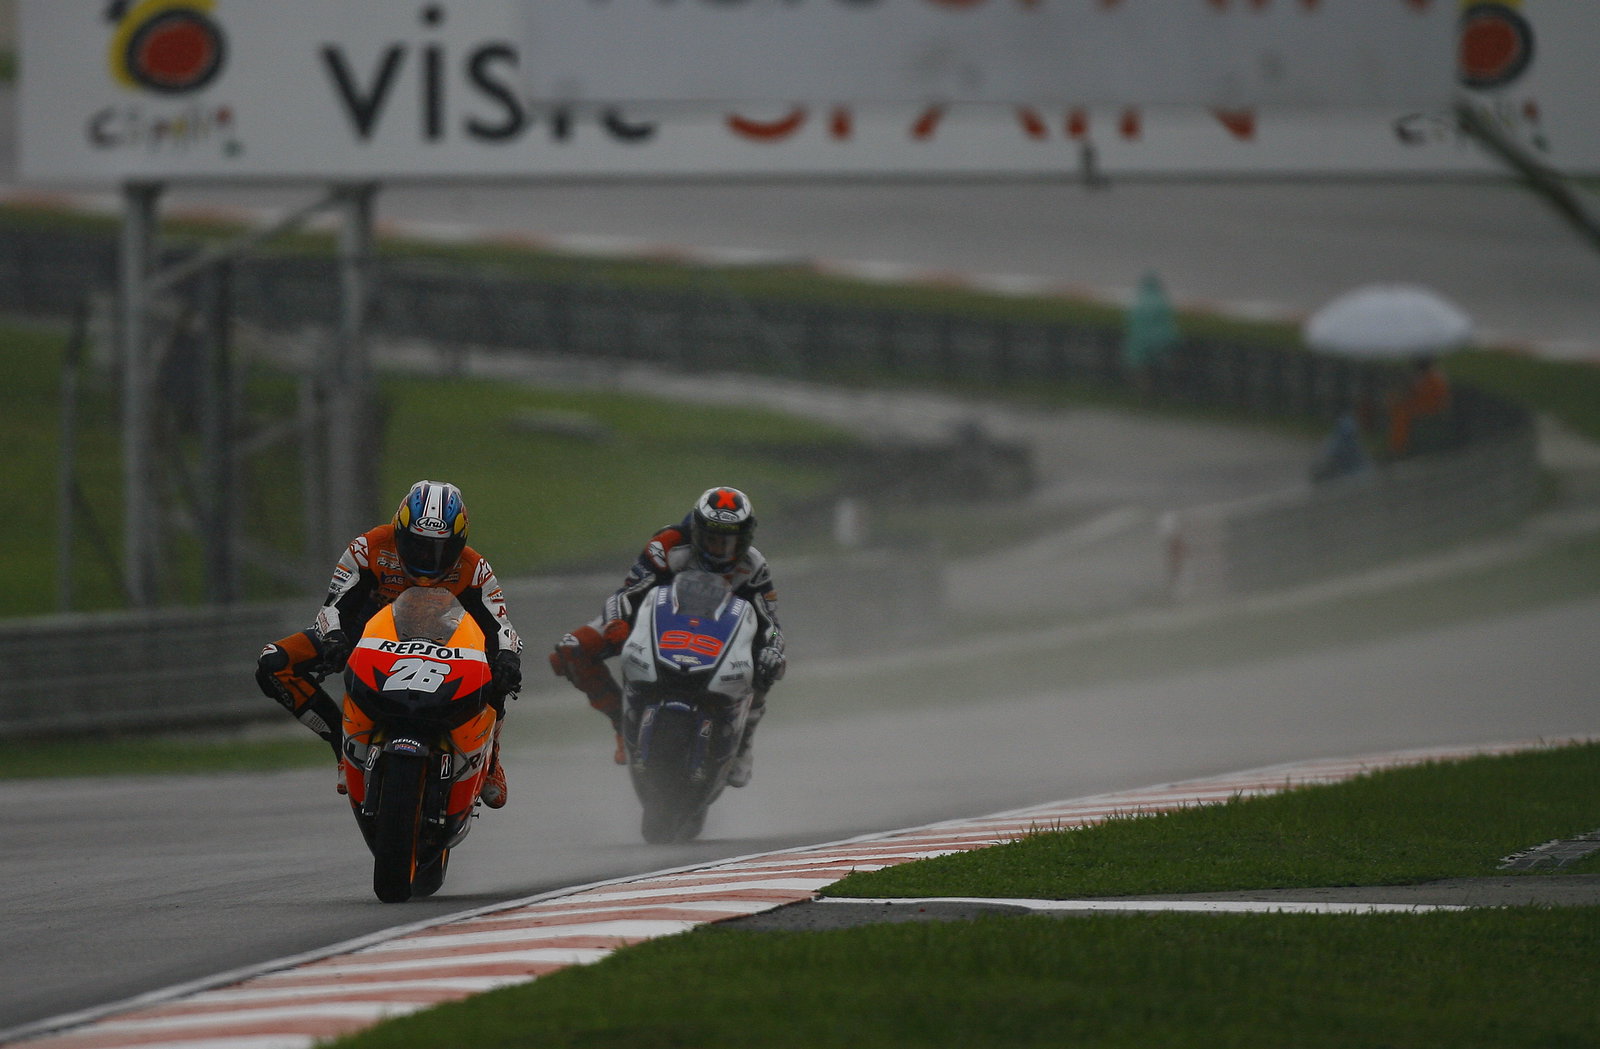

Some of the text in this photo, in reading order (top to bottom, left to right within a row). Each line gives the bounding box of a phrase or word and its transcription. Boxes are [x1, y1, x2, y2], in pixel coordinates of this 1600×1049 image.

[420, 517, 443, 529] Arai
[378, 640, 464, 660] REPSOL
[658, 629, 724, 657] 99
[382, 657, 452, 693] 26
[391, 738, 422, 748] REPSOL
